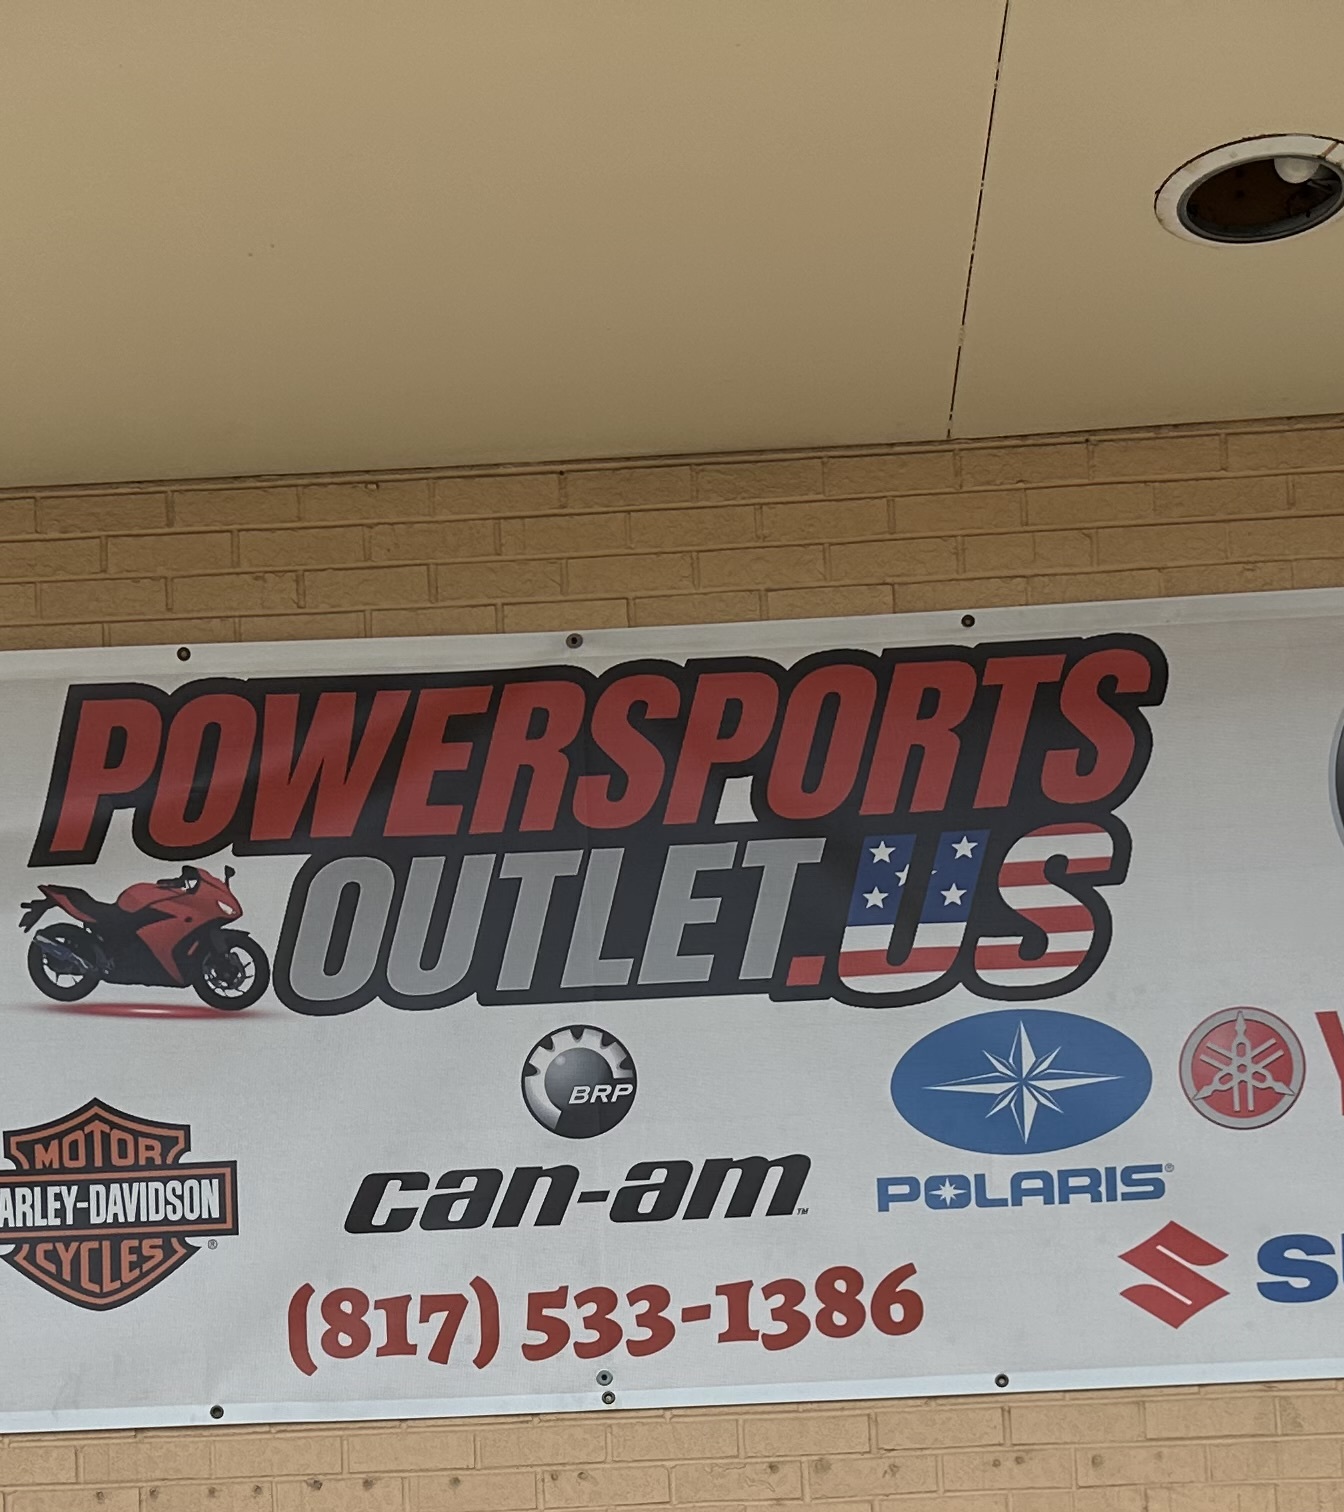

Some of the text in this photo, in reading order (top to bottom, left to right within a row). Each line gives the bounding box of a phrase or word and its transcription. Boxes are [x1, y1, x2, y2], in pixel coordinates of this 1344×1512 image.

[34, 637, 1163, 862] POWERSPORTS
[280, 823, 1124, 1010] OUTLET.US
[569, 1082, 634, 1105] BRP
[34, 1125, 161, 1168] MOTOR
[343, 1152, 813, 1235] can-am
[877, 1165, 1166, 1213] POLARIS
[34, 1237, 165, 1291] CYCLES
[287, 1262, 925, 1377] (817) 533-1386
